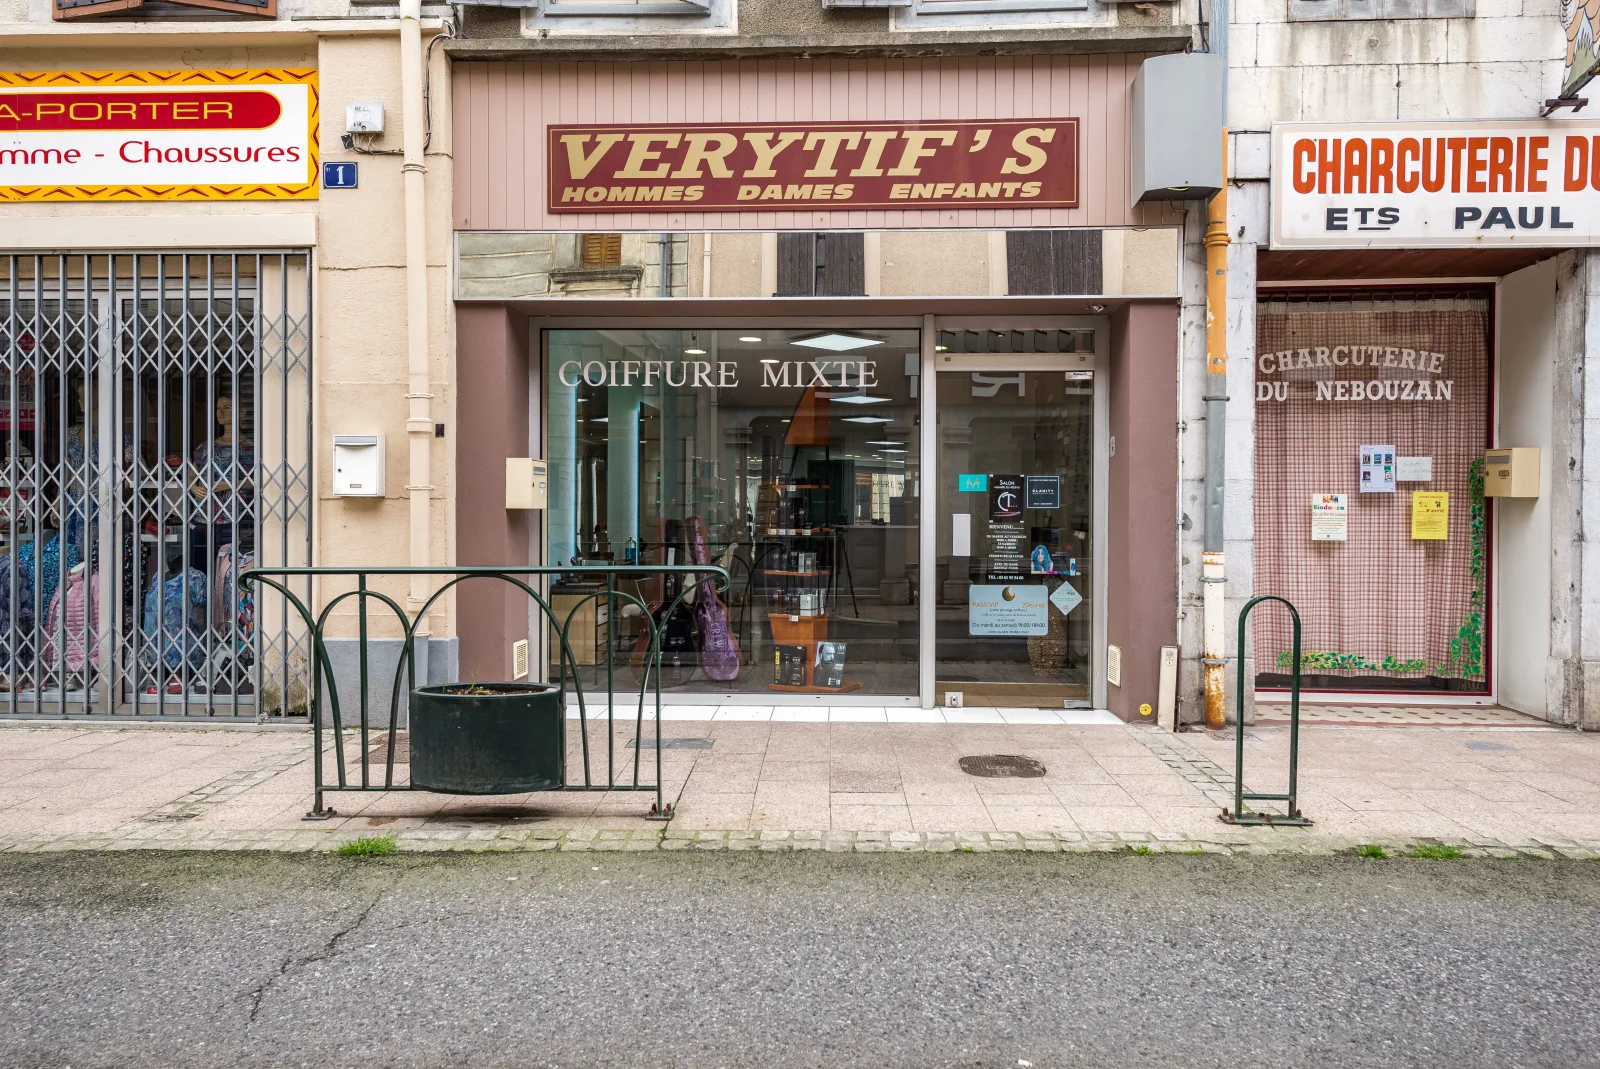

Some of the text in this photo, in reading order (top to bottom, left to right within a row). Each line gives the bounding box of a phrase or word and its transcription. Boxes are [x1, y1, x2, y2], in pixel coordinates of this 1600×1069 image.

[0, 102, 234, 121] A-PORTER
[119, 140, 301, 164] Chaussures
[560, 127, 1057, 180] VERYTIF'S
[336, 165, 345, 185] 1
[1292, 136, 1550, 195] CHARCUTERIE
[560, 181, 1043, 203] HOMMES DAMES ENFANTS
[1325, 205, 1574, 232] ETS PAUL
[1258, 346, 1446, 374] CHARCUTERIE
[558, 359, 879, 388] COIFFURE MIXTE
[1255, 379, 1454, 401] DU NEBOUZAN
